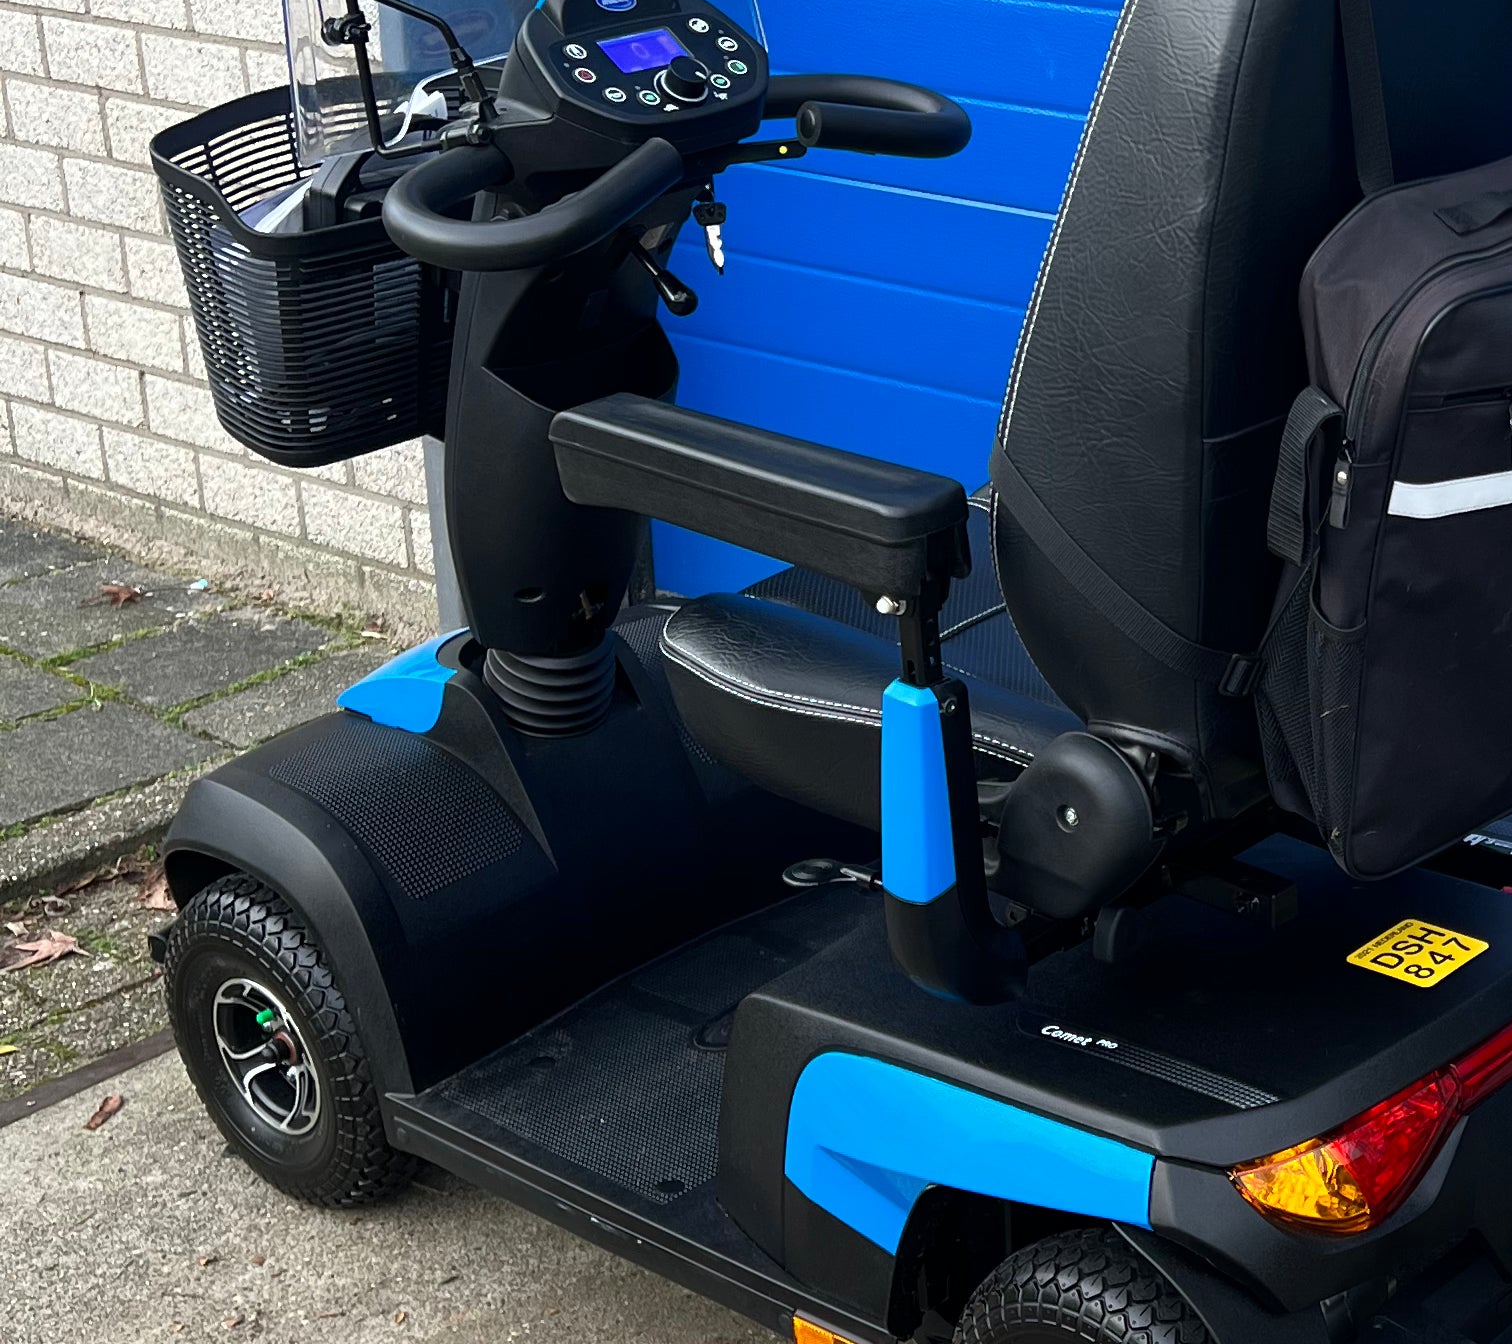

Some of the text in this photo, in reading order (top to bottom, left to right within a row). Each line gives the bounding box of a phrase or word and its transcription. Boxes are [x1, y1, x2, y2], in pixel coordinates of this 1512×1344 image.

[1369, 926, 1446, 969] DSH
[1403, 937, 1471, 979] 847
[1041, 1025, 1093, 1046] Comet
